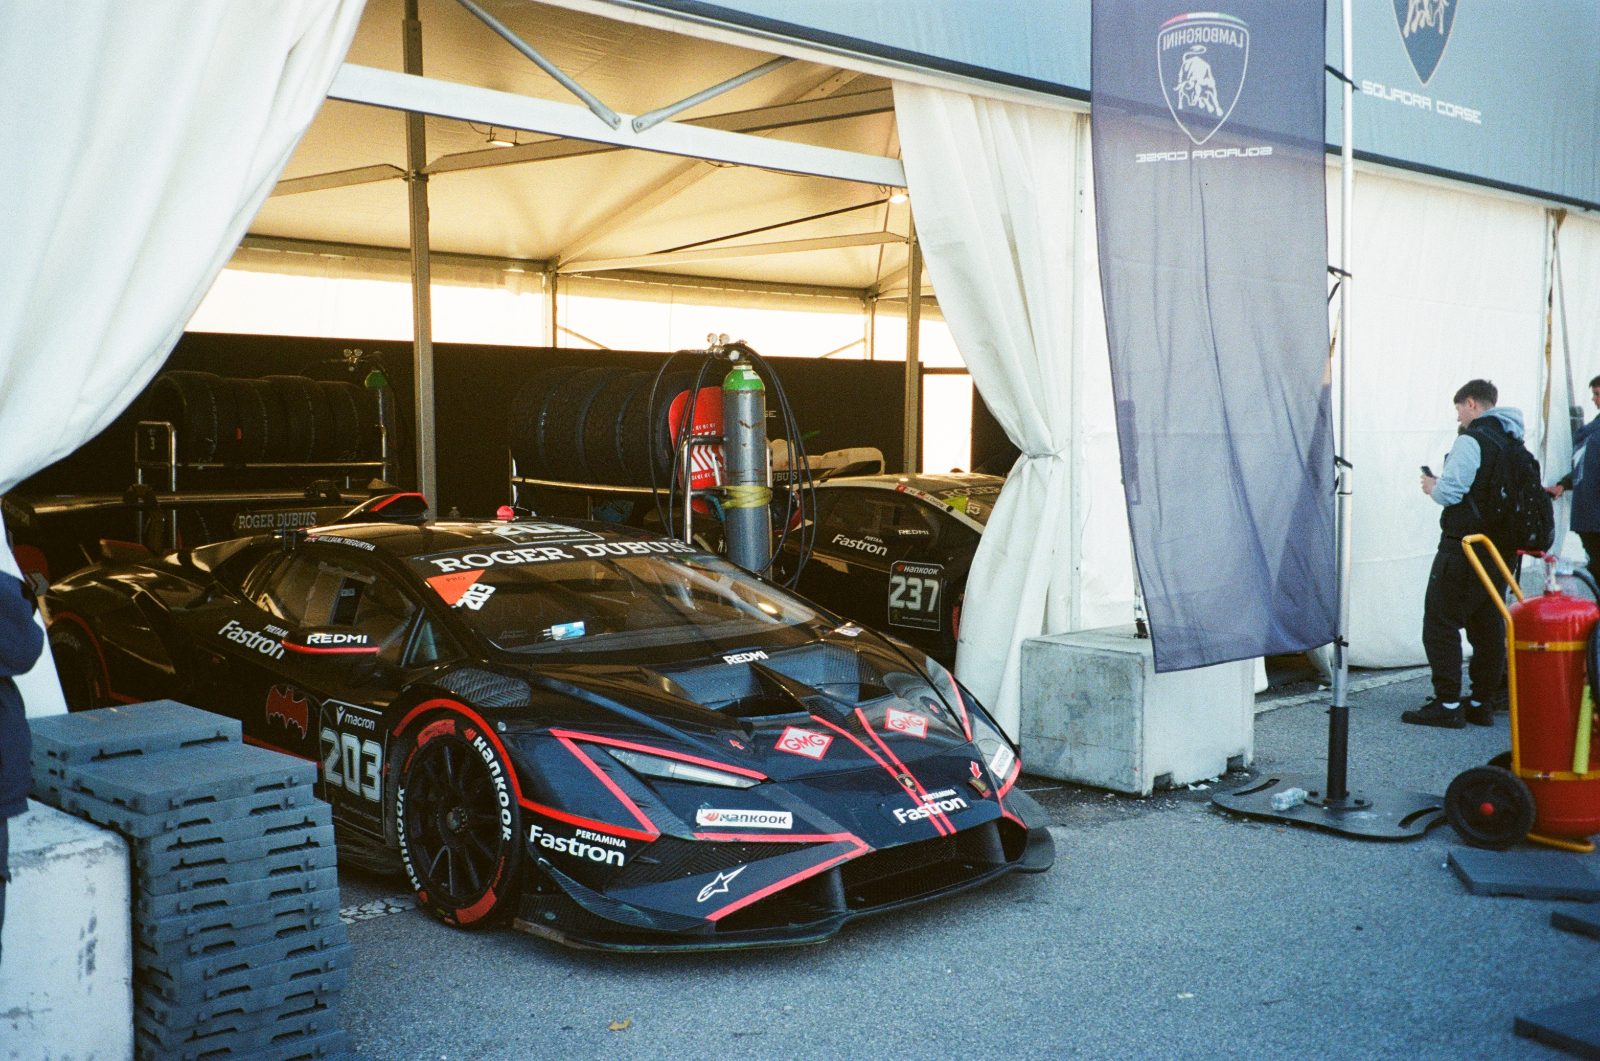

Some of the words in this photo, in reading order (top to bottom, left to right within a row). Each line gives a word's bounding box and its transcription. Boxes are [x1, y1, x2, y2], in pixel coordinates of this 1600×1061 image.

[1361, 80, 1432, 111] SQUADRA
[1436, 100, 1482, 124] CORSE
[238, 514, 275, 529] ROGER
[277, 511, 317, 527] DUBUIS
[430, 547, 575, 573] ROGER
[573, 541, 697, 557] DUBUIS
[832, 533, 888, 556] Fastron
[454, 582, 496, 611] 203
[890, 575, 939, 613] 237
[218, 619, 286, 660] Fastron
[306, 633, 368, 645] REDMI
[722, 650, 769, 665] REDMI
[344, 712, 376, 731] macron
[889, 714, 923, 732] GMG
[784, 734, 825, 751] GMG
[321, 727, 383, 803] 203
[893, 797, 968, 825] Fastron
[528, 824, 626, 867] Fastron
[575, 828, 627, 849] PERTAMINA
